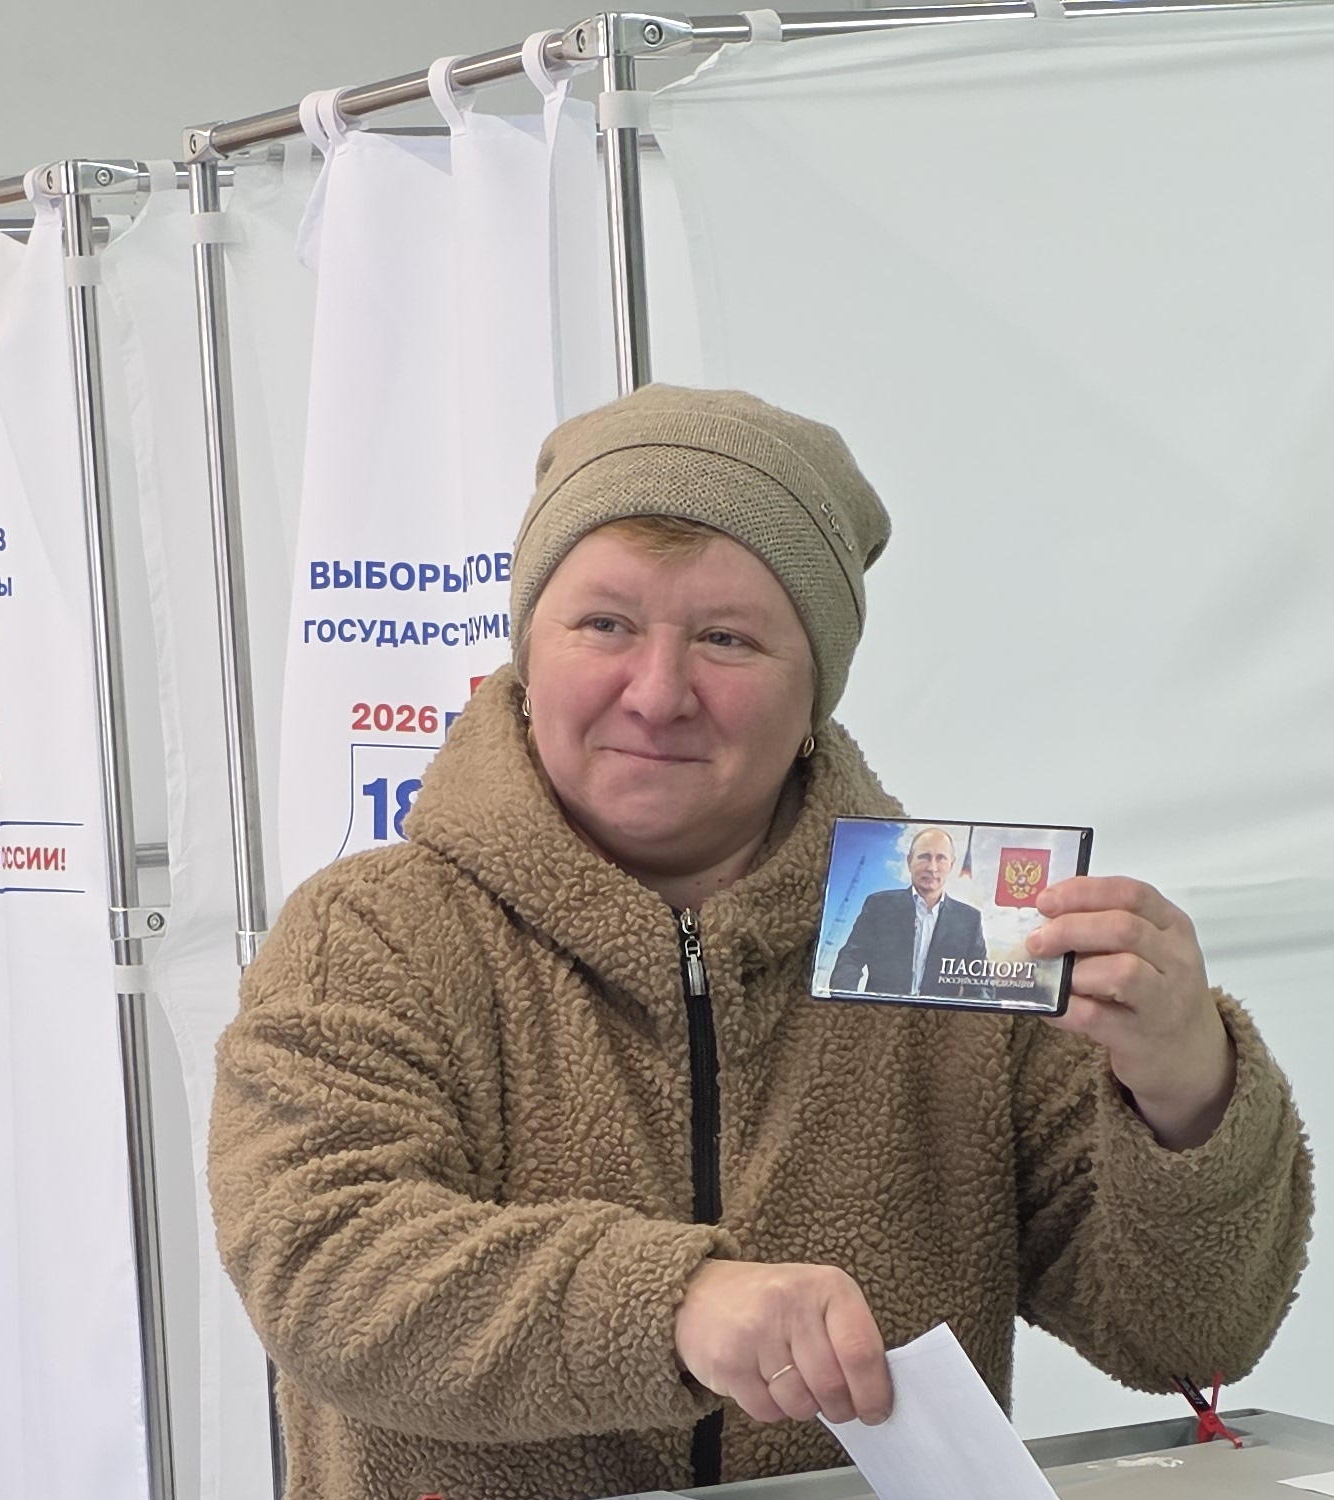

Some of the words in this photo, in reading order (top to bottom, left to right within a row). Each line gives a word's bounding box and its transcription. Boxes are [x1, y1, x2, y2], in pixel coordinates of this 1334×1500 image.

[310, 560, 467, 593] ВЫБОРЫ
[465, 552, 512, 586] ТОВ
[304, 618, 468, 647] ГОСУДАРСТ
[351, 702, 438, 734] 2026
[1, 845, 66, 871] ССИИ!
[939, 957, 1037, 979] ПАСПОРТ
